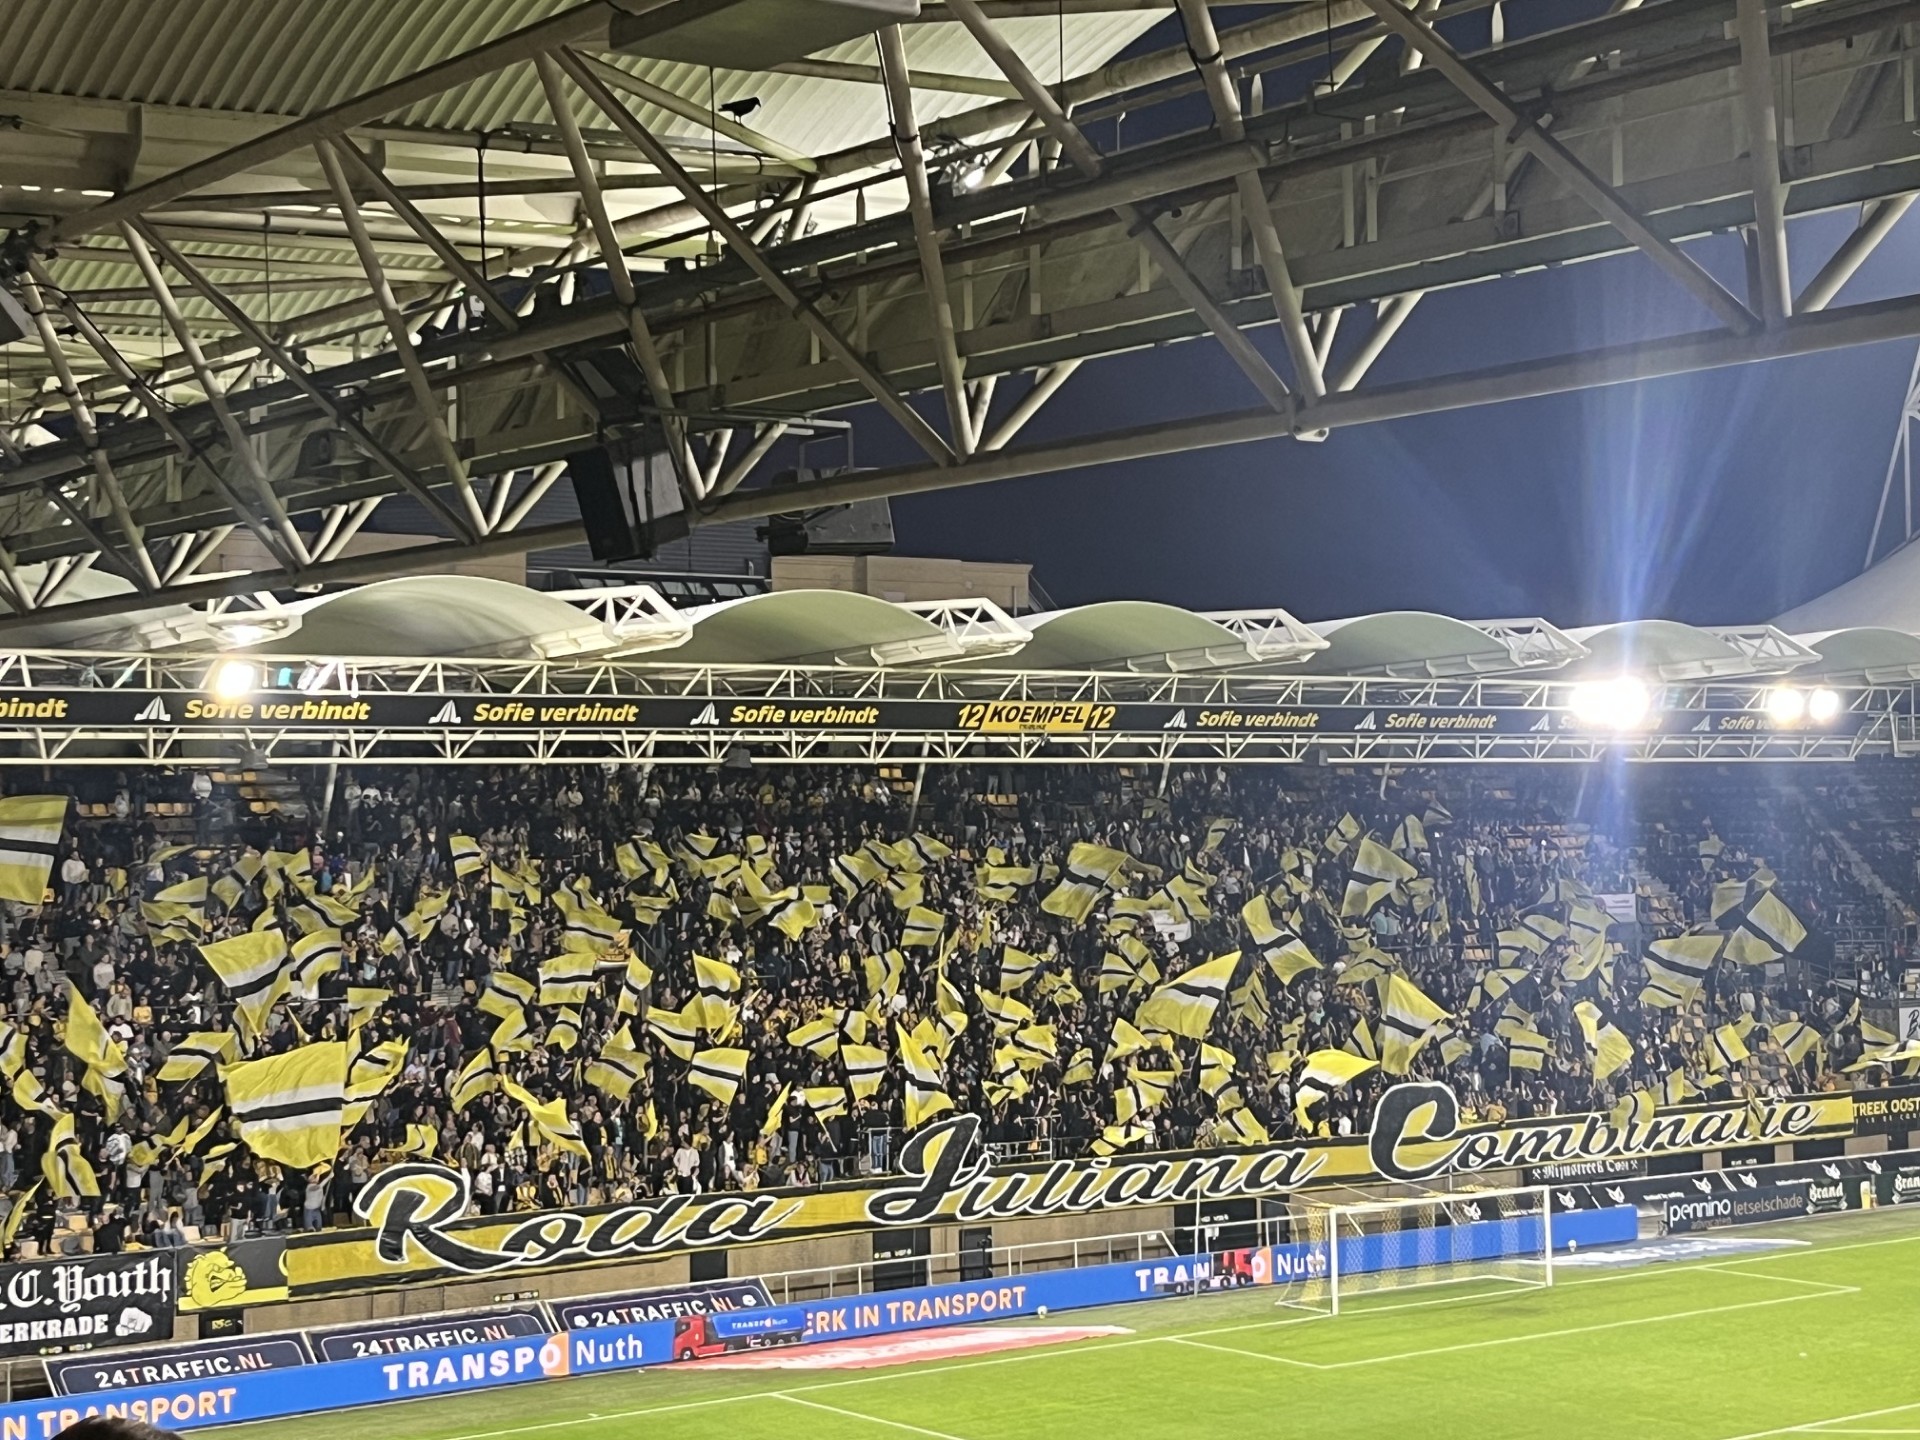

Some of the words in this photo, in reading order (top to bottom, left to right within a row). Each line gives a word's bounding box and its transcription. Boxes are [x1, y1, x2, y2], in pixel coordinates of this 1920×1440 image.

[185, 699, 254, 719] Sofie
[260, 701, 371, 720] verbindt
[473, 703, 534, 722] Sofie
[540, 704, 640, 722] verbindt
[730, 705, 786, 723] Sofie
[789, 706, 879, 724] verbindt
[957, 704, 986, 728] 12
[988, 705, 1086, 724] KOEMPEL
[1089, 705, 1117, 729] 12
[1196, 711, 1241, 728] Sofie
[1244, 712, 1319, 729] verbindt
[1385, 713, 1426, 729] Sofie
[1428, 714, 1497, 729] verbindt
[353, 1163, 806, 1273] Roda
[865, 1113, 1328, 1223] Juliana
[1670, 1196, 1731, 1228] pennino
[592, 1297, 742, 1328] 24TRAFFIC.NL
[855, 1301, 881, 1328] IN
[887, 1285, 1027, 1322] TRANSPORT
[352, 1325, 516, 1358] 24TRAFFIC.NL
[576, 1334, 643, 1366] Nuth
[95, 1352, 272, 1388] 24TRAFFIC.NL
